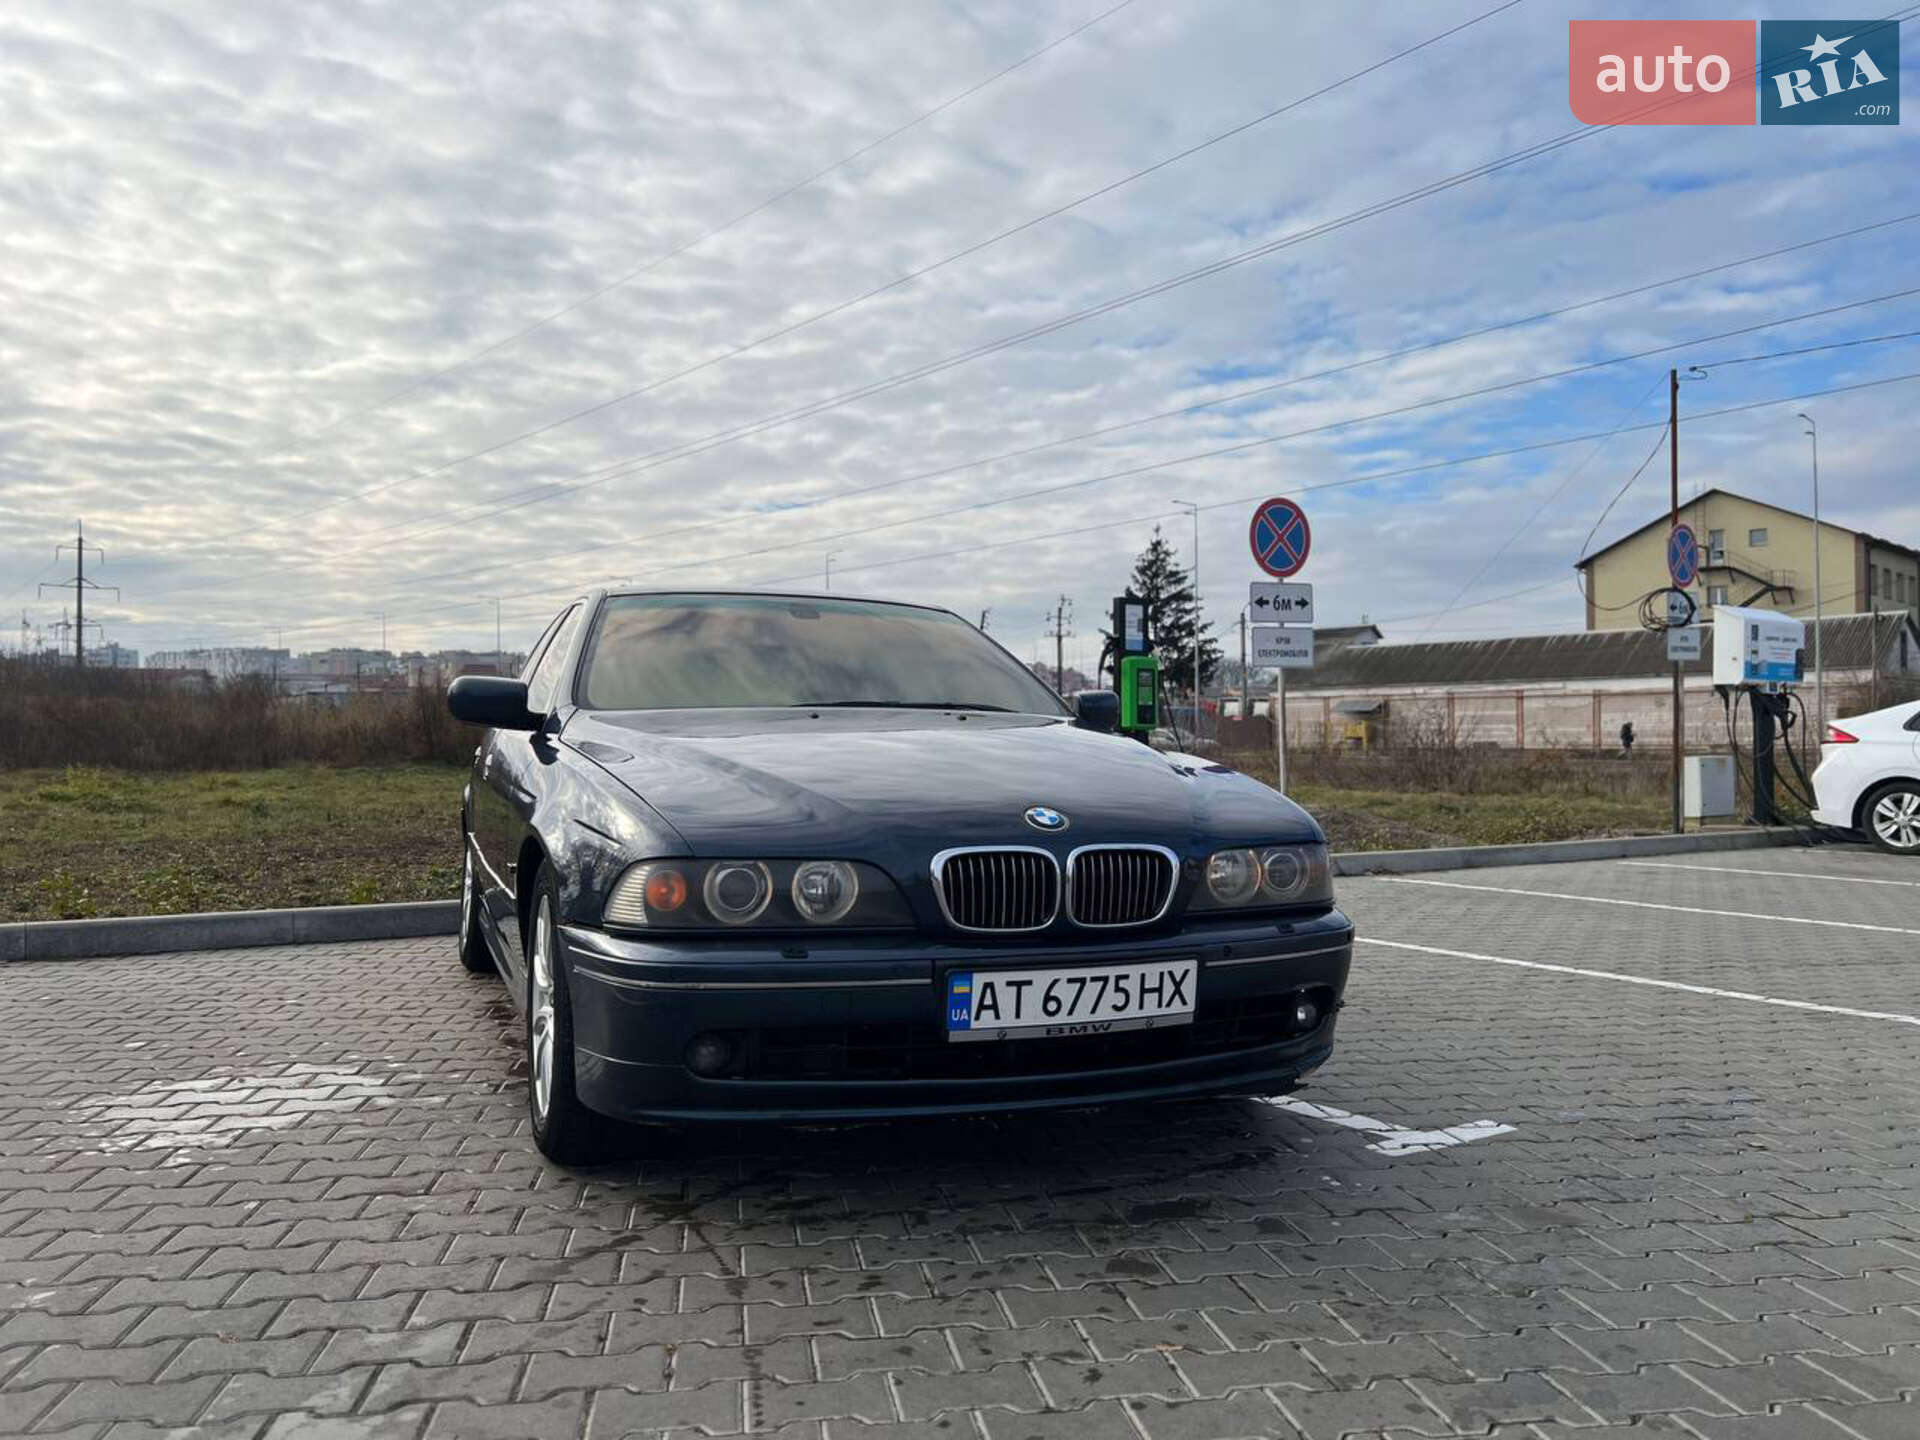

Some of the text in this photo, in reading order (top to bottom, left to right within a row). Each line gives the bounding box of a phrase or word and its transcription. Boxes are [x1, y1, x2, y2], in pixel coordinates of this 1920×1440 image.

[974, 969, 1191, 1021] AT 6775 HX
[951, 1008, 969, 1022] UA
[1045, 1022, 1112, 1036] BMW
